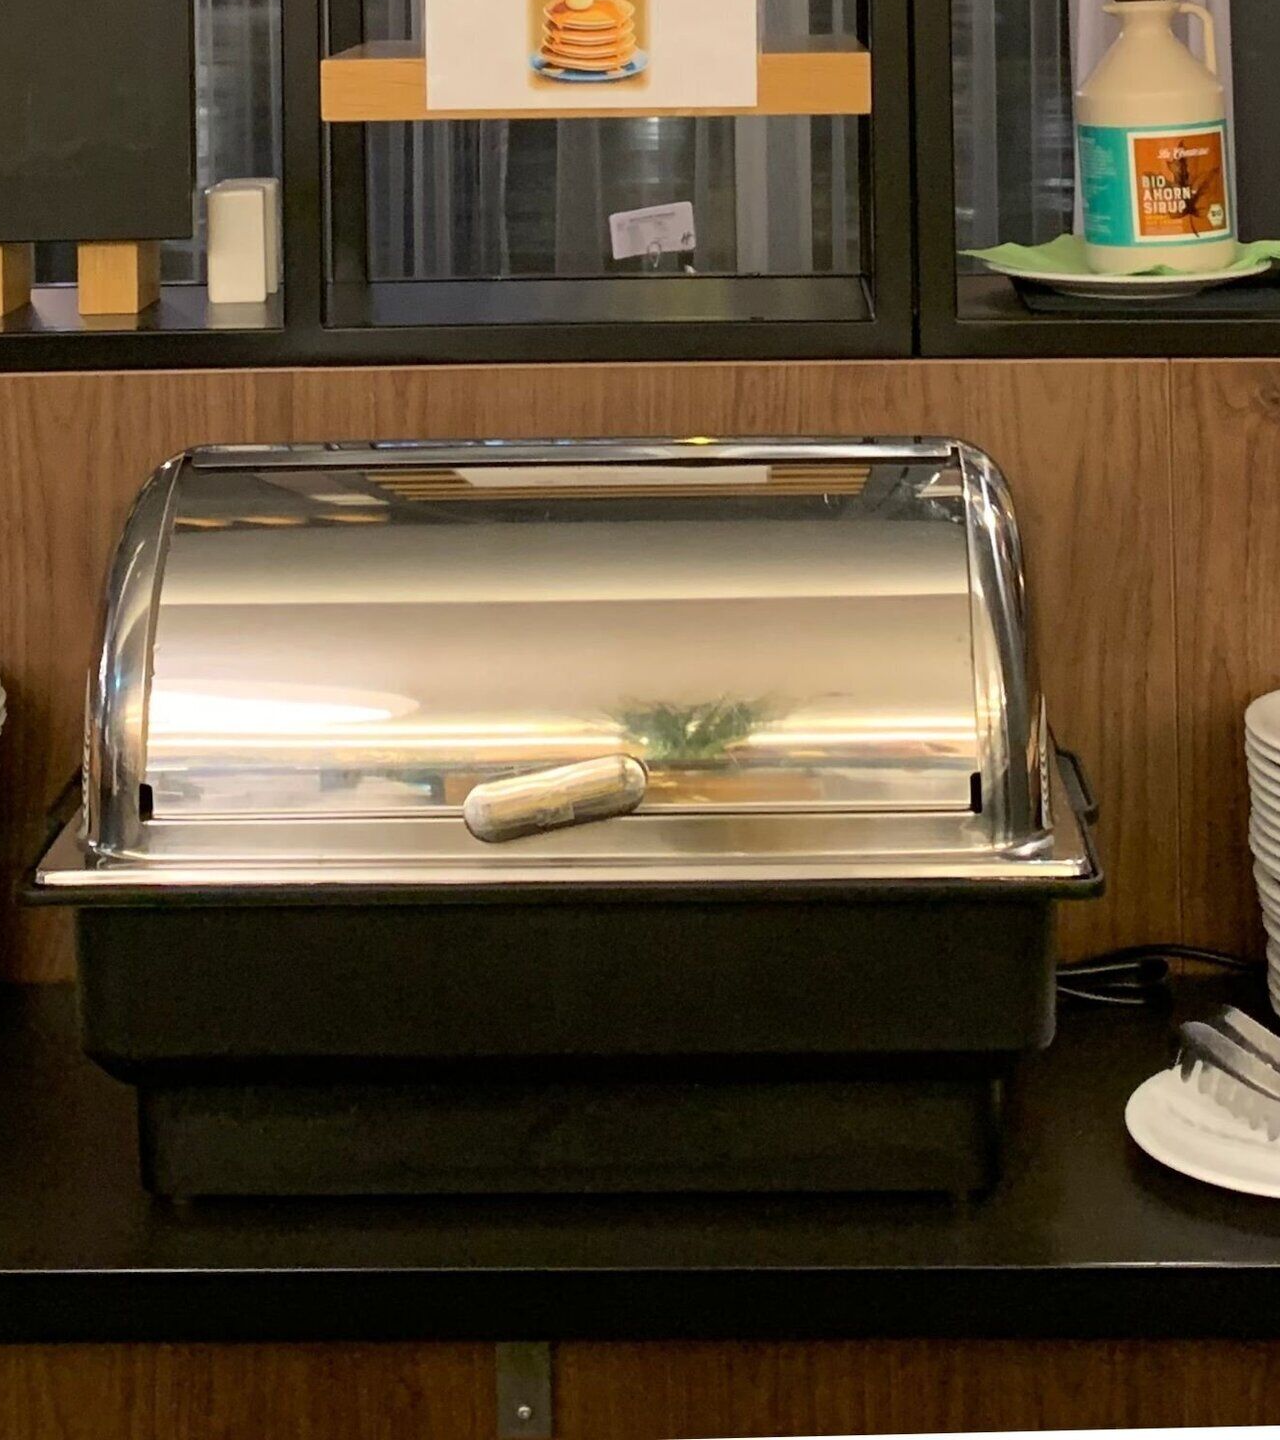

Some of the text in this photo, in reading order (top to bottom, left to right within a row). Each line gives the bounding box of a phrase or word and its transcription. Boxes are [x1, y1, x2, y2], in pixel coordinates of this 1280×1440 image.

[1141, 175, 1166, 189] BIO
[1143, 187, 1197, 201] AHORN-
[1143, 200, 1187, 215] SIRUP
